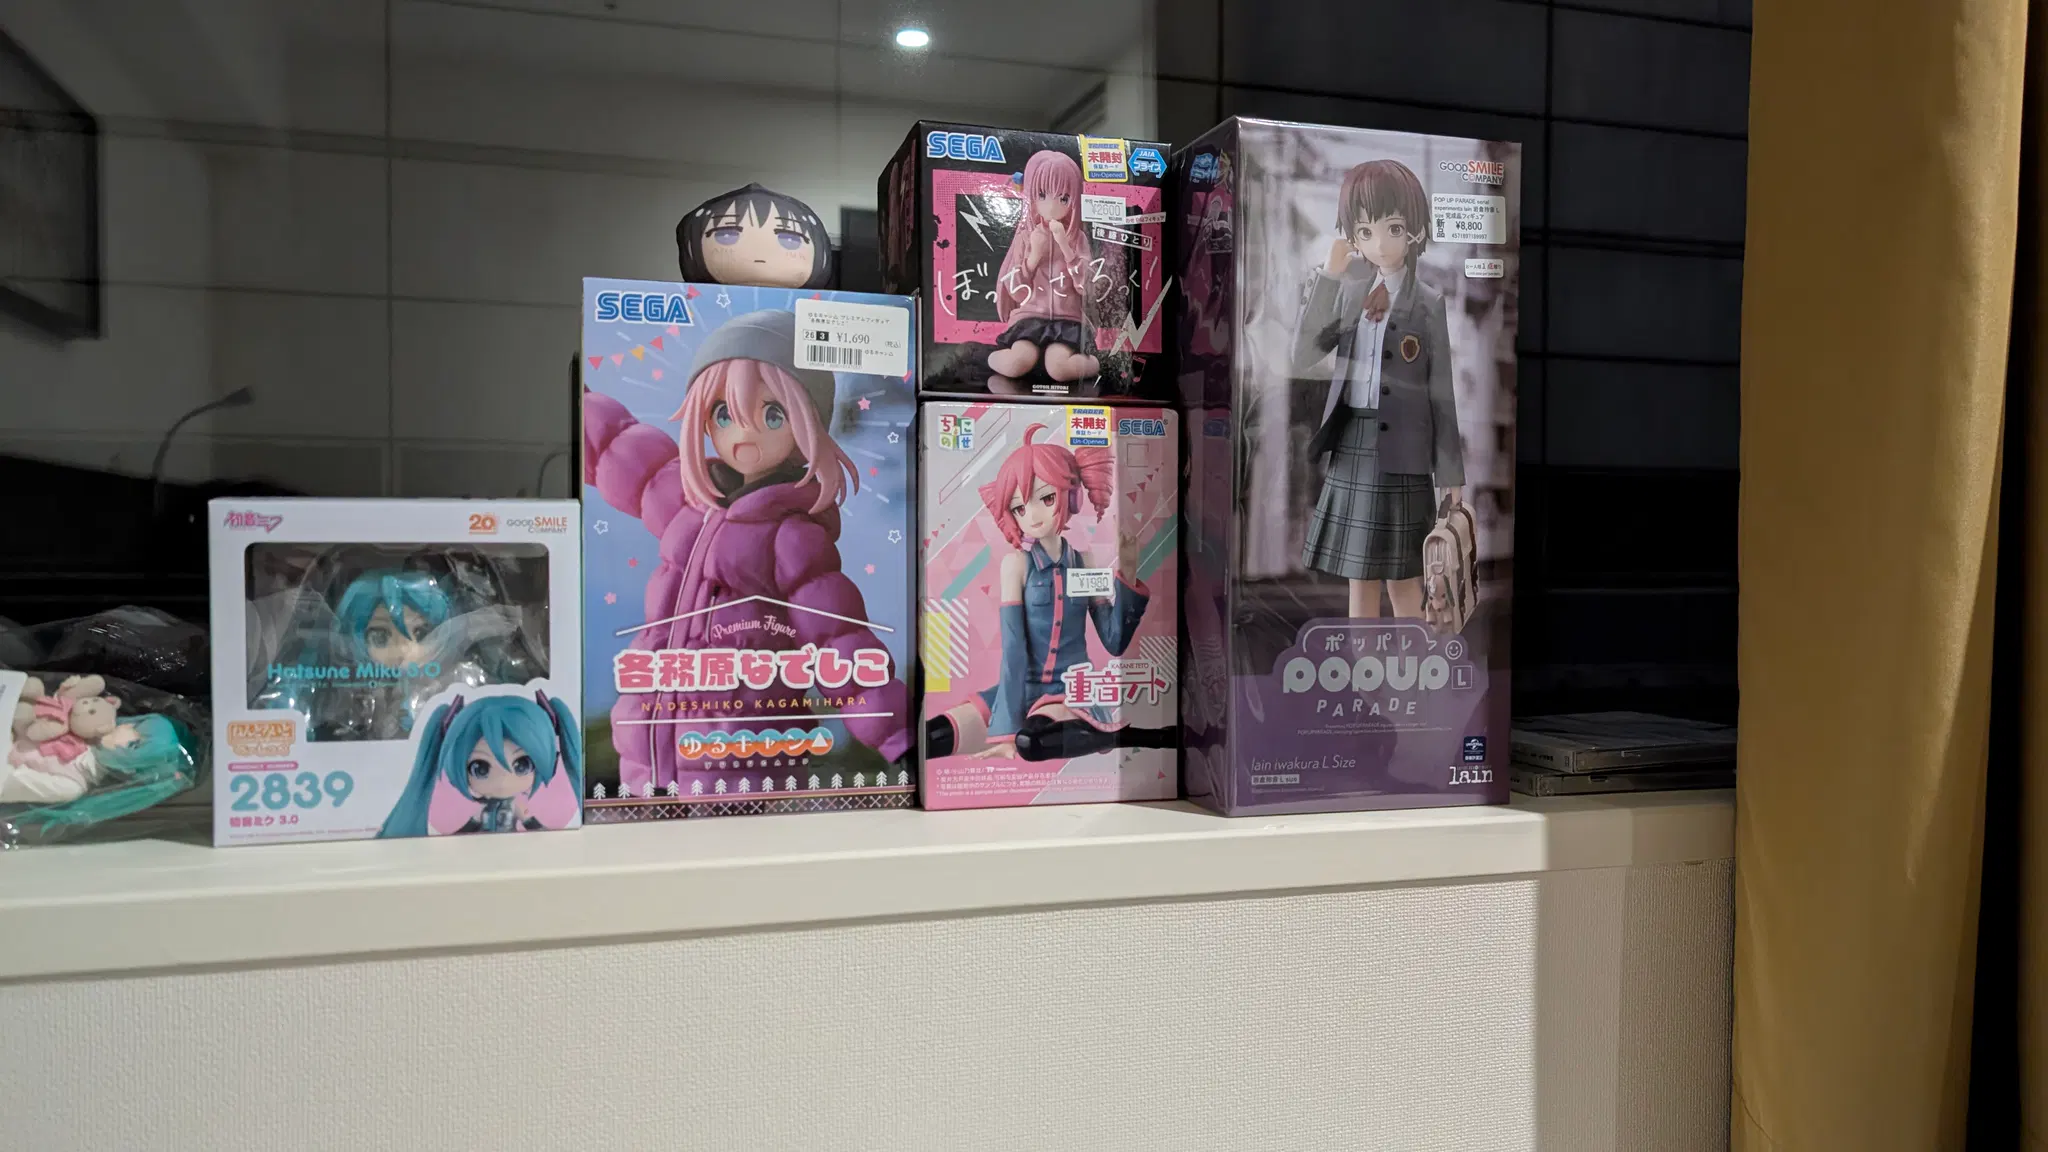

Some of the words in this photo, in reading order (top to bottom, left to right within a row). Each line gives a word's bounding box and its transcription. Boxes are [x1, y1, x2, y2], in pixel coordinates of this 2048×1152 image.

[927, 131, 1007, 164] SEGA
[1088, 151, 1123, 164] 未開封
[1440, 162, 1468, 172] GOOD
[1468, 160, 1504, 176] SMILE
[1462, 173, 1504, 185] COMPANY
[1445, 212, 1485, 220] 完成品フィギュア
[1436, 218, 1446, 238] 新品
[1455, 220, 1483, 231] ¥8,800
[595, 289, 695, 327] SEGA
[804, 331, 815, 339] 26
[819, 332, 826, 340] 3
[1071, 417, 1107, 430] 未開封
[1119, 419, 1166, 437] SEGA
[469, 513, 496, 531] 20
[1079, 576, 1109, 589] ¥1980
[712, 620, 762, 639] Premium
[763, 615, 797, 638] Figure
[267, 663, 350, 680] Hatsune
[355, 661, 402, 679] Miku
[616, 645, 890, 691] 各務原なでしこ
[1063, 665, 1167, 703] 重音テト
[641, 699, 744, 712] NADESHIKO
[754, 696, 868, 709] KAGAMIHARA
[1316, 697, 1417, 717] PARADE
[1273, 757, 1320, 770] iwakura
[1322, 755, 1330, 769] L
[1332, 754, 1357, 769] Size
[1448, 765, 1494, 785] lain
[230, 770, 355, 812] 2839
[279, 814, 299, 826] 3.0
